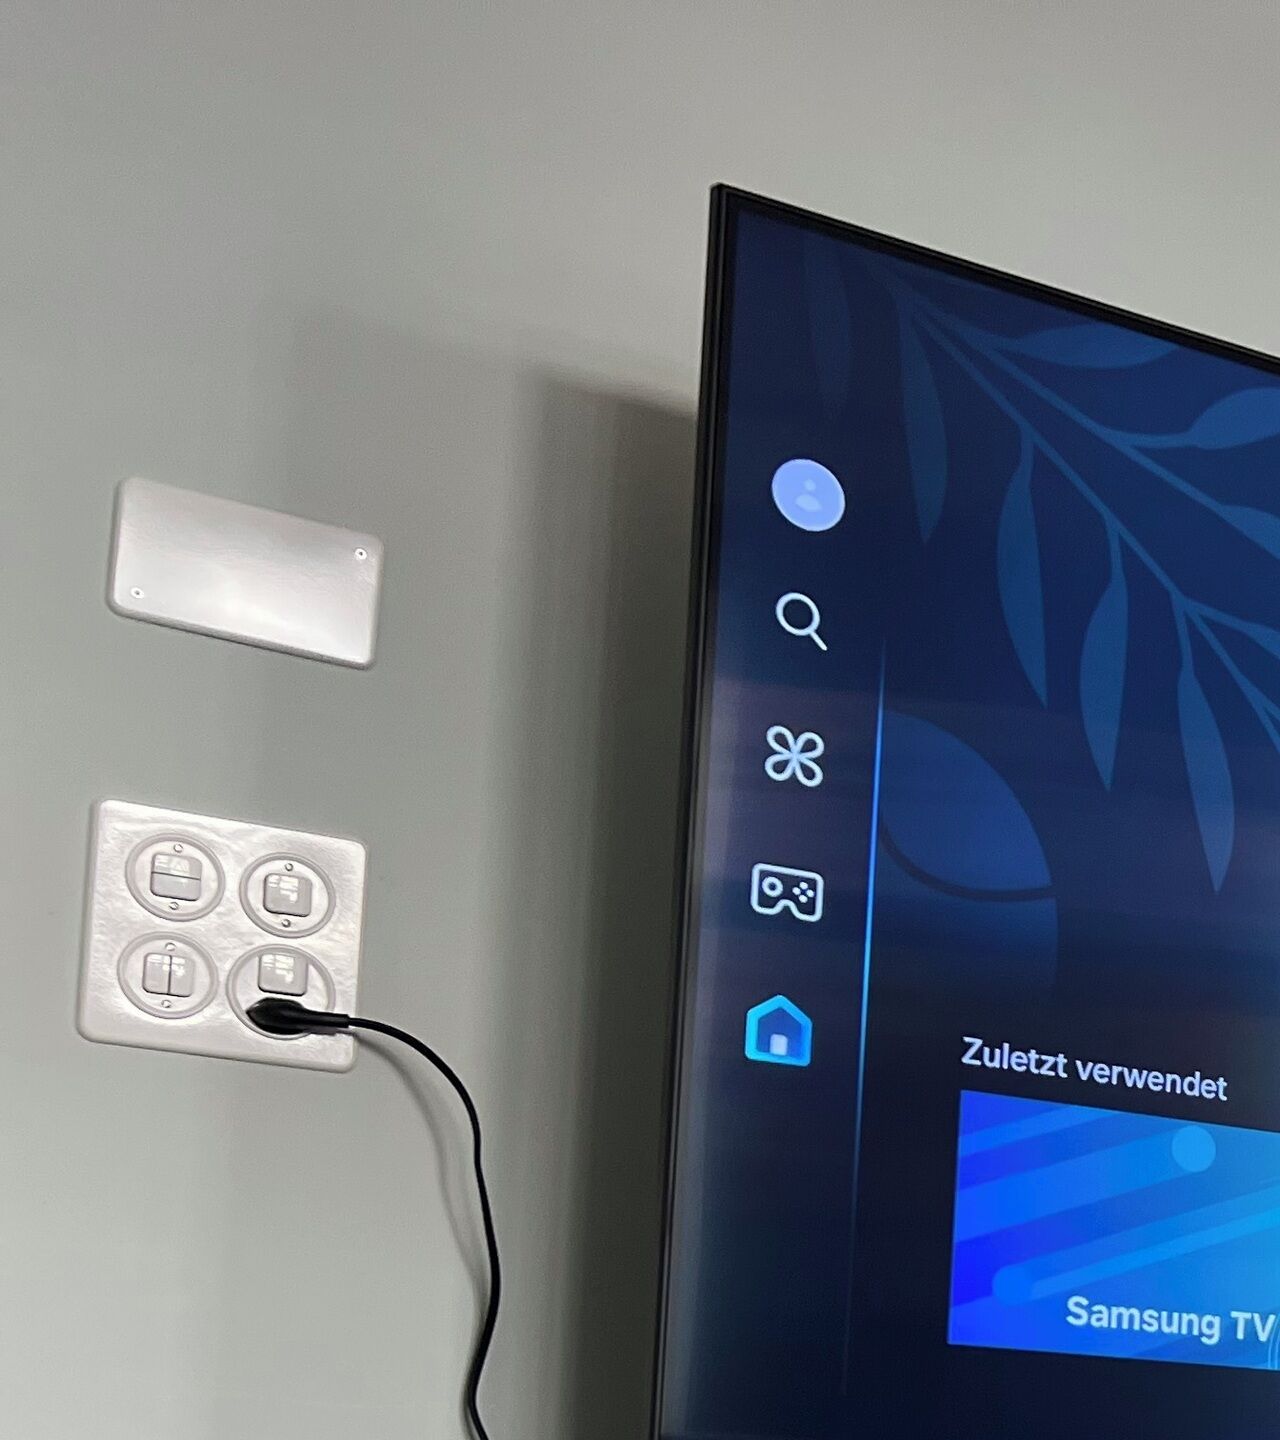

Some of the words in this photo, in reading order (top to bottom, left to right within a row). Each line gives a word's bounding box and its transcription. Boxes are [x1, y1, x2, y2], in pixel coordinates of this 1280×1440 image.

[961, 1036, 1068, 1078] Zuletzt
[1076, 1060, 1228, 1101] verwendet
[1066, 1297, 1221, 1345] Samsung
[1230, 1310, 1272, 1342] TV
